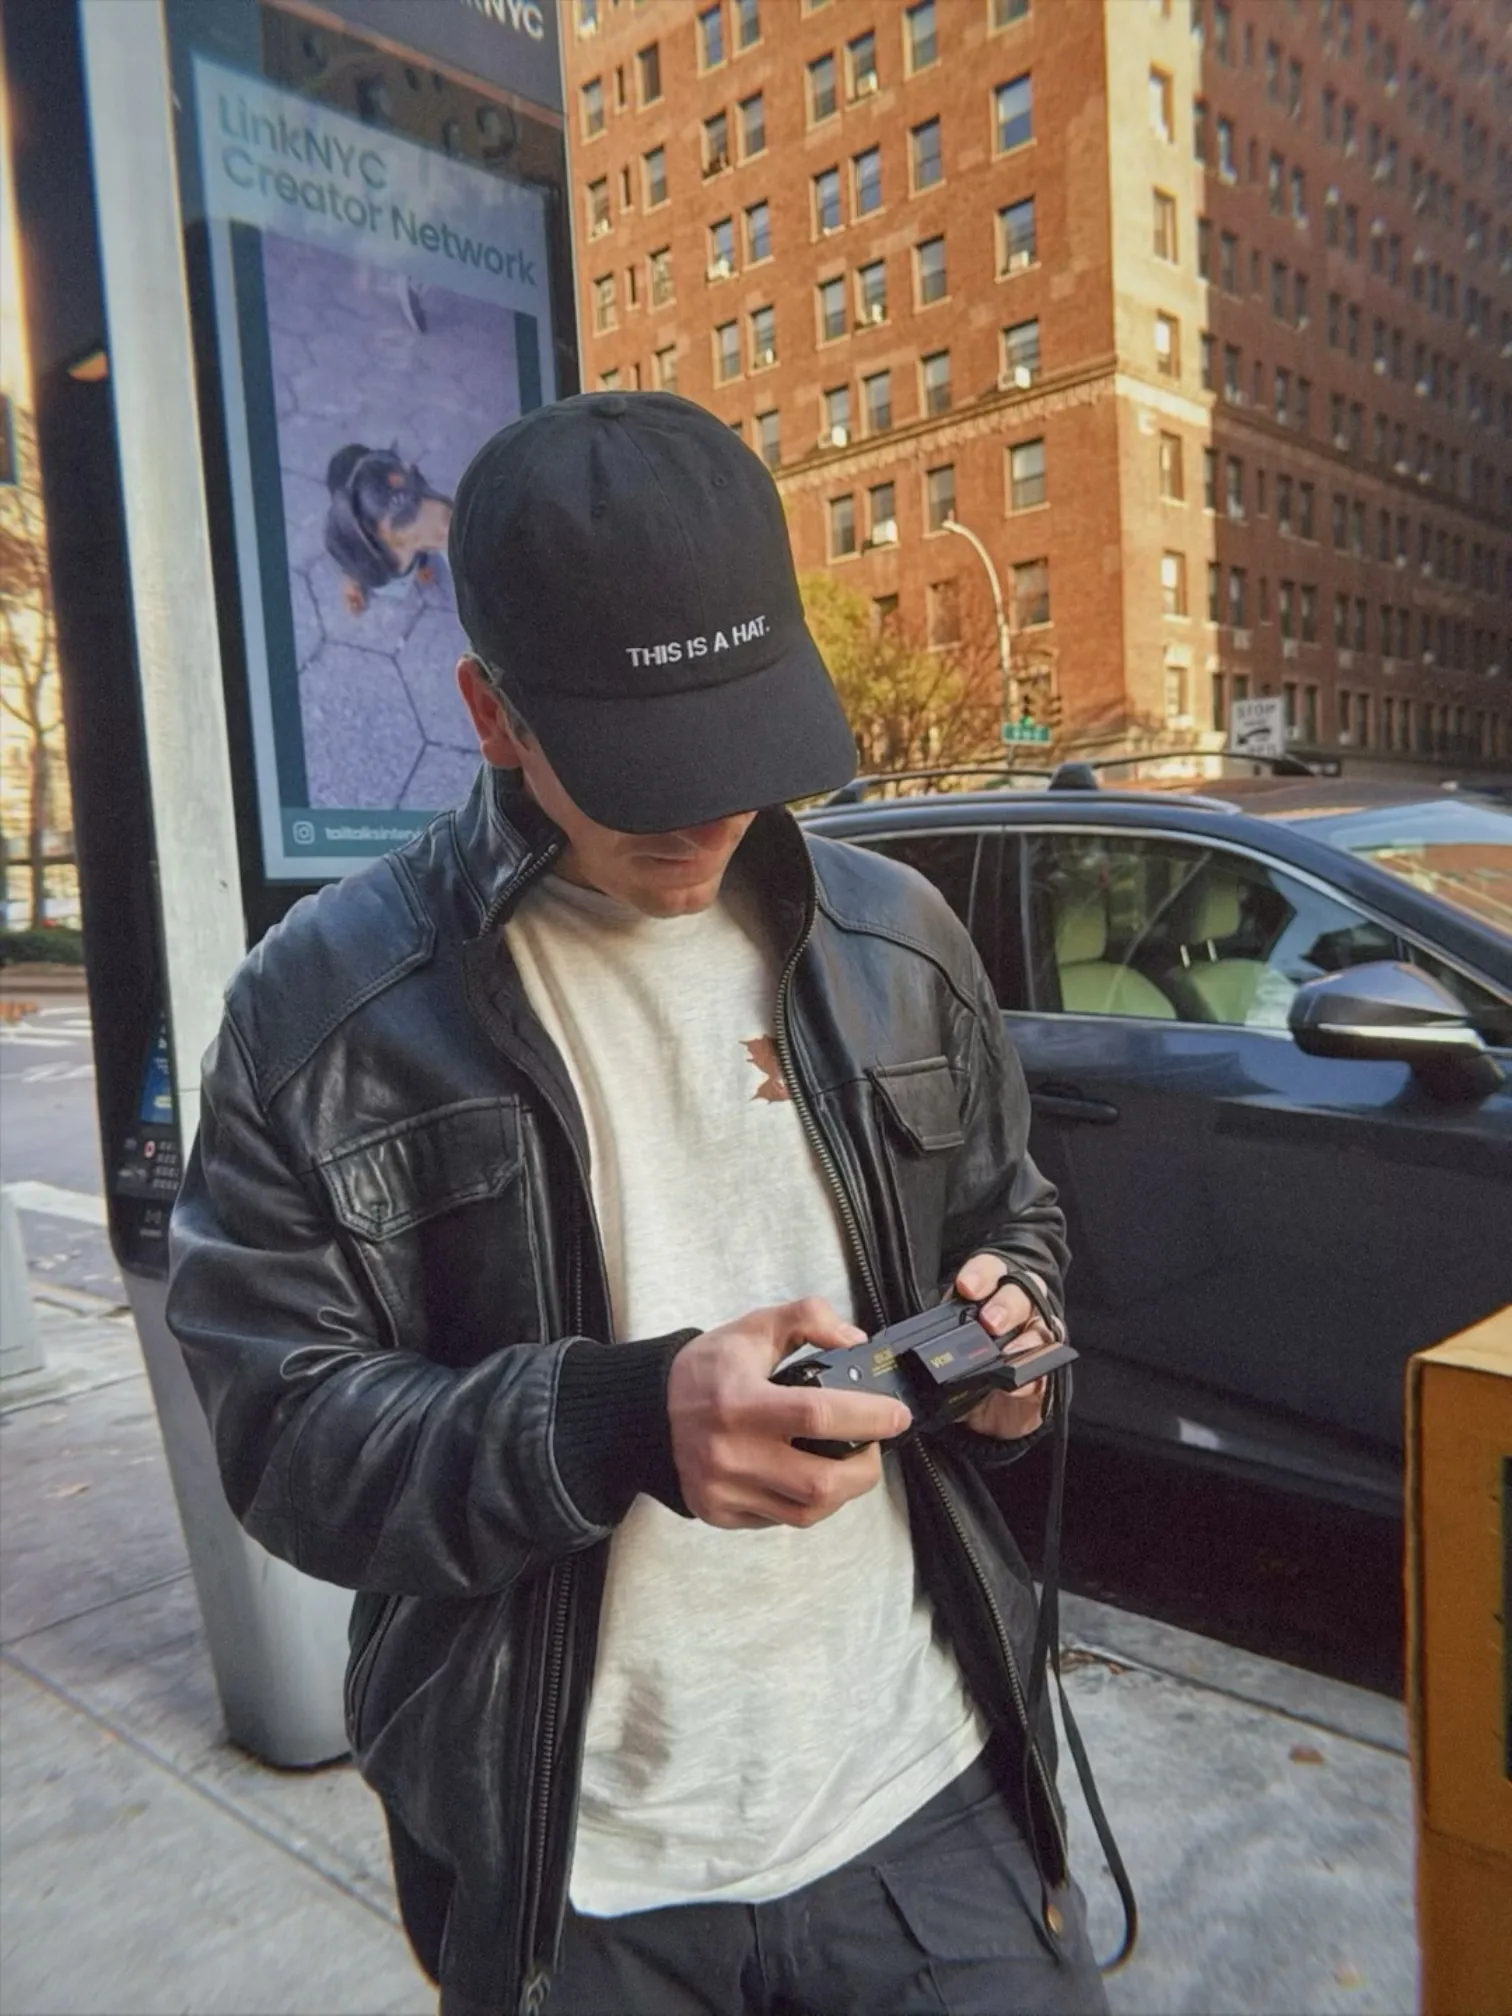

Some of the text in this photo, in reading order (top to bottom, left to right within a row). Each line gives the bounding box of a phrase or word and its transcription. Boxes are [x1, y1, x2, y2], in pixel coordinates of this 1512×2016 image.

[218, 93, 388, 190] LinkNYC
[222, 146, 537, 287] Creator Network
[625, 615, 771, 667] THIS IS A HAT.
